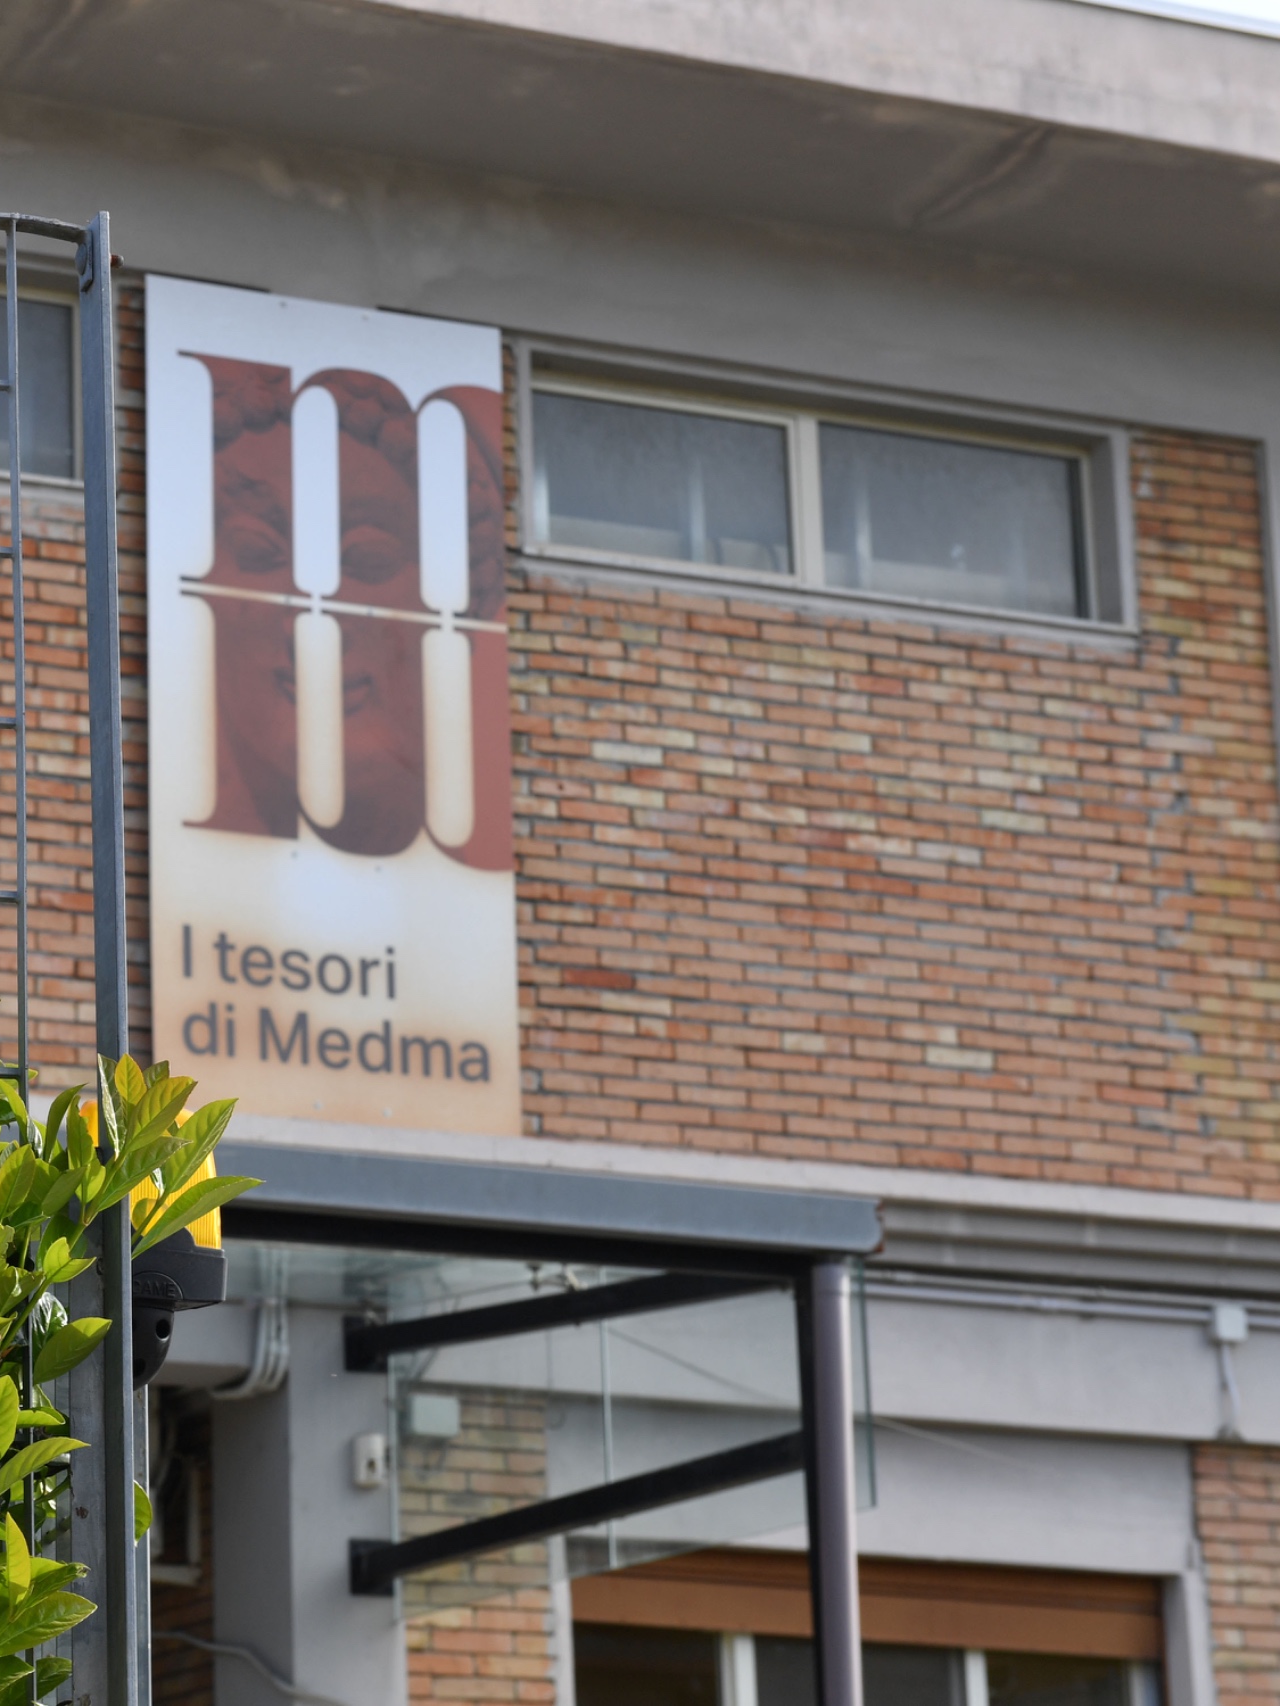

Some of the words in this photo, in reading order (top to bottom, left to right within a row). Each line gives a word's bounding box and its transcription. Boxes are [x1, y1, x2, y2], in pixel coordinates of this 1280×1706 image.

[181, 923, 194, 979] I
[213, 932, 396, 1000] tesori
[181, 1000, 238, 1060] di
[256, 1005, 492, 1085] Medma
